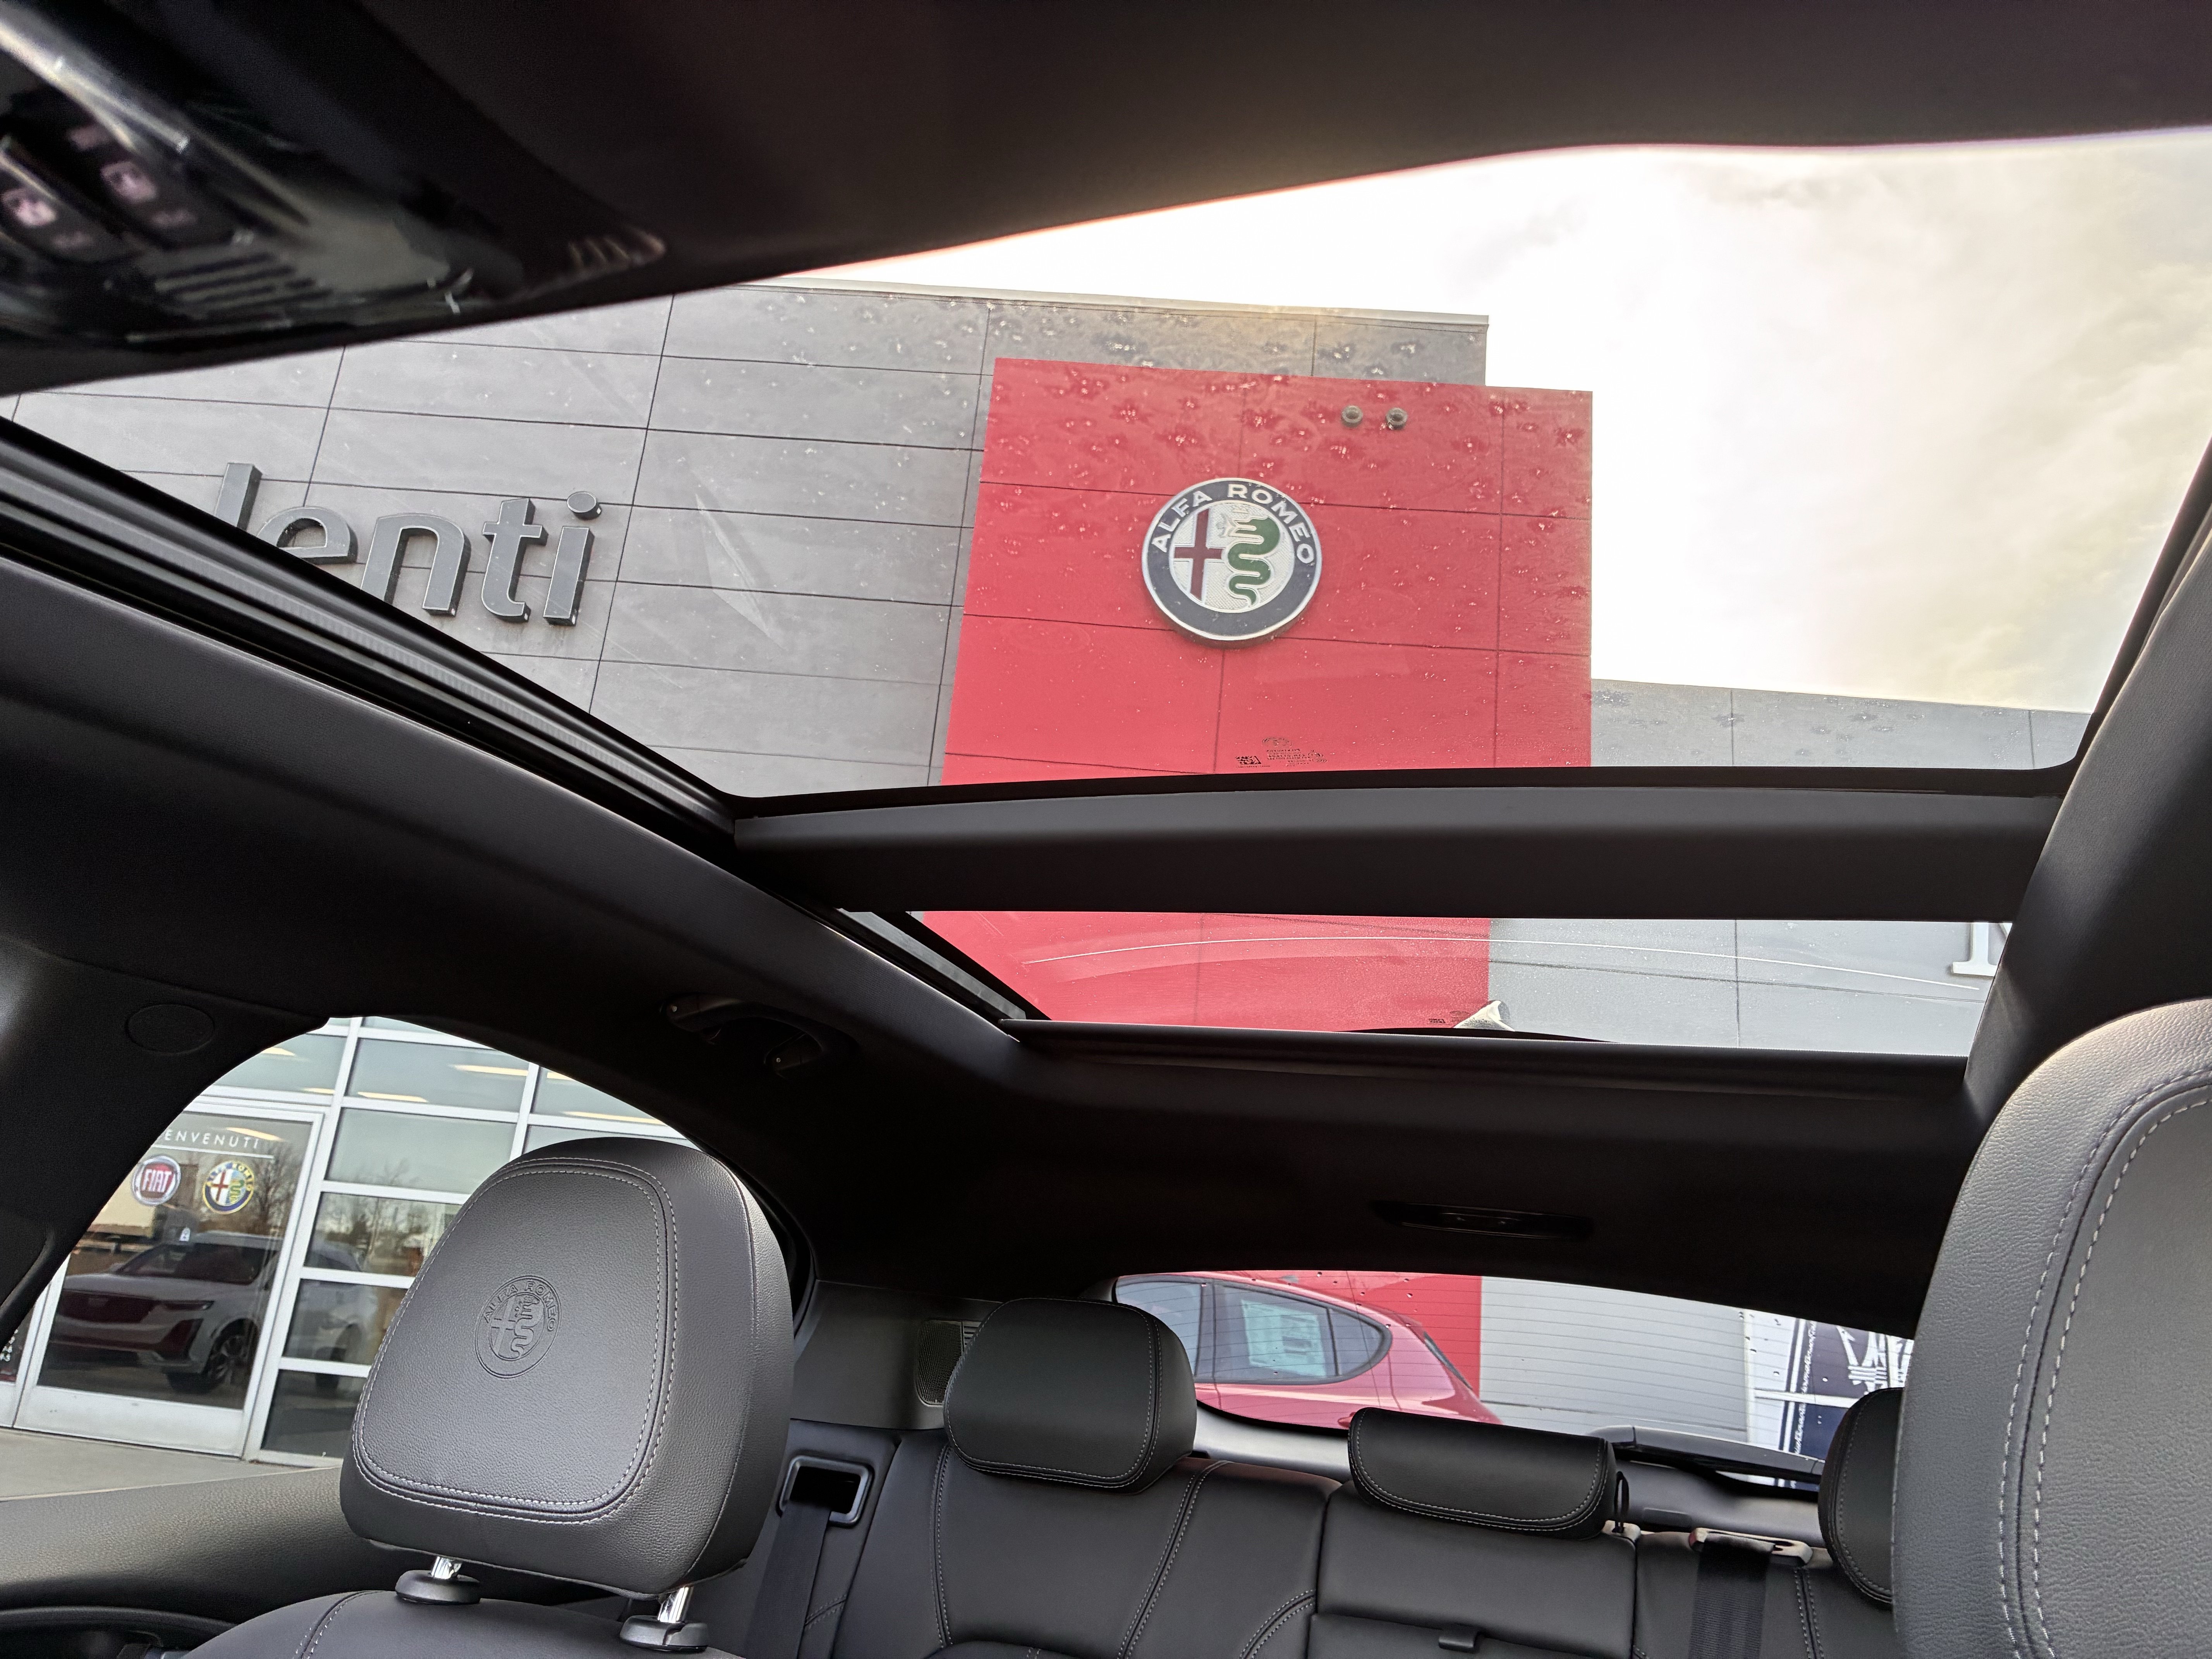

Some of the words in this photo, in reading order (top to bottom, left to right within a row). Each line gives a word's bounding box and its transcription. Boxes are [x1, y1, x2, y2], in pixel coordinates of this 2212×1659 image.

[1151, 490, 1212, 553] ALFA
[1227, 483, 1315, 564] ROMEO
[164, 1128, 259, 1149] ENVENUTI
[142, 1168, 172, 1193] FIAT
[484, 1284, 519, 1323] ALFA
[524, 1281, 556, 1332] ROMEO
